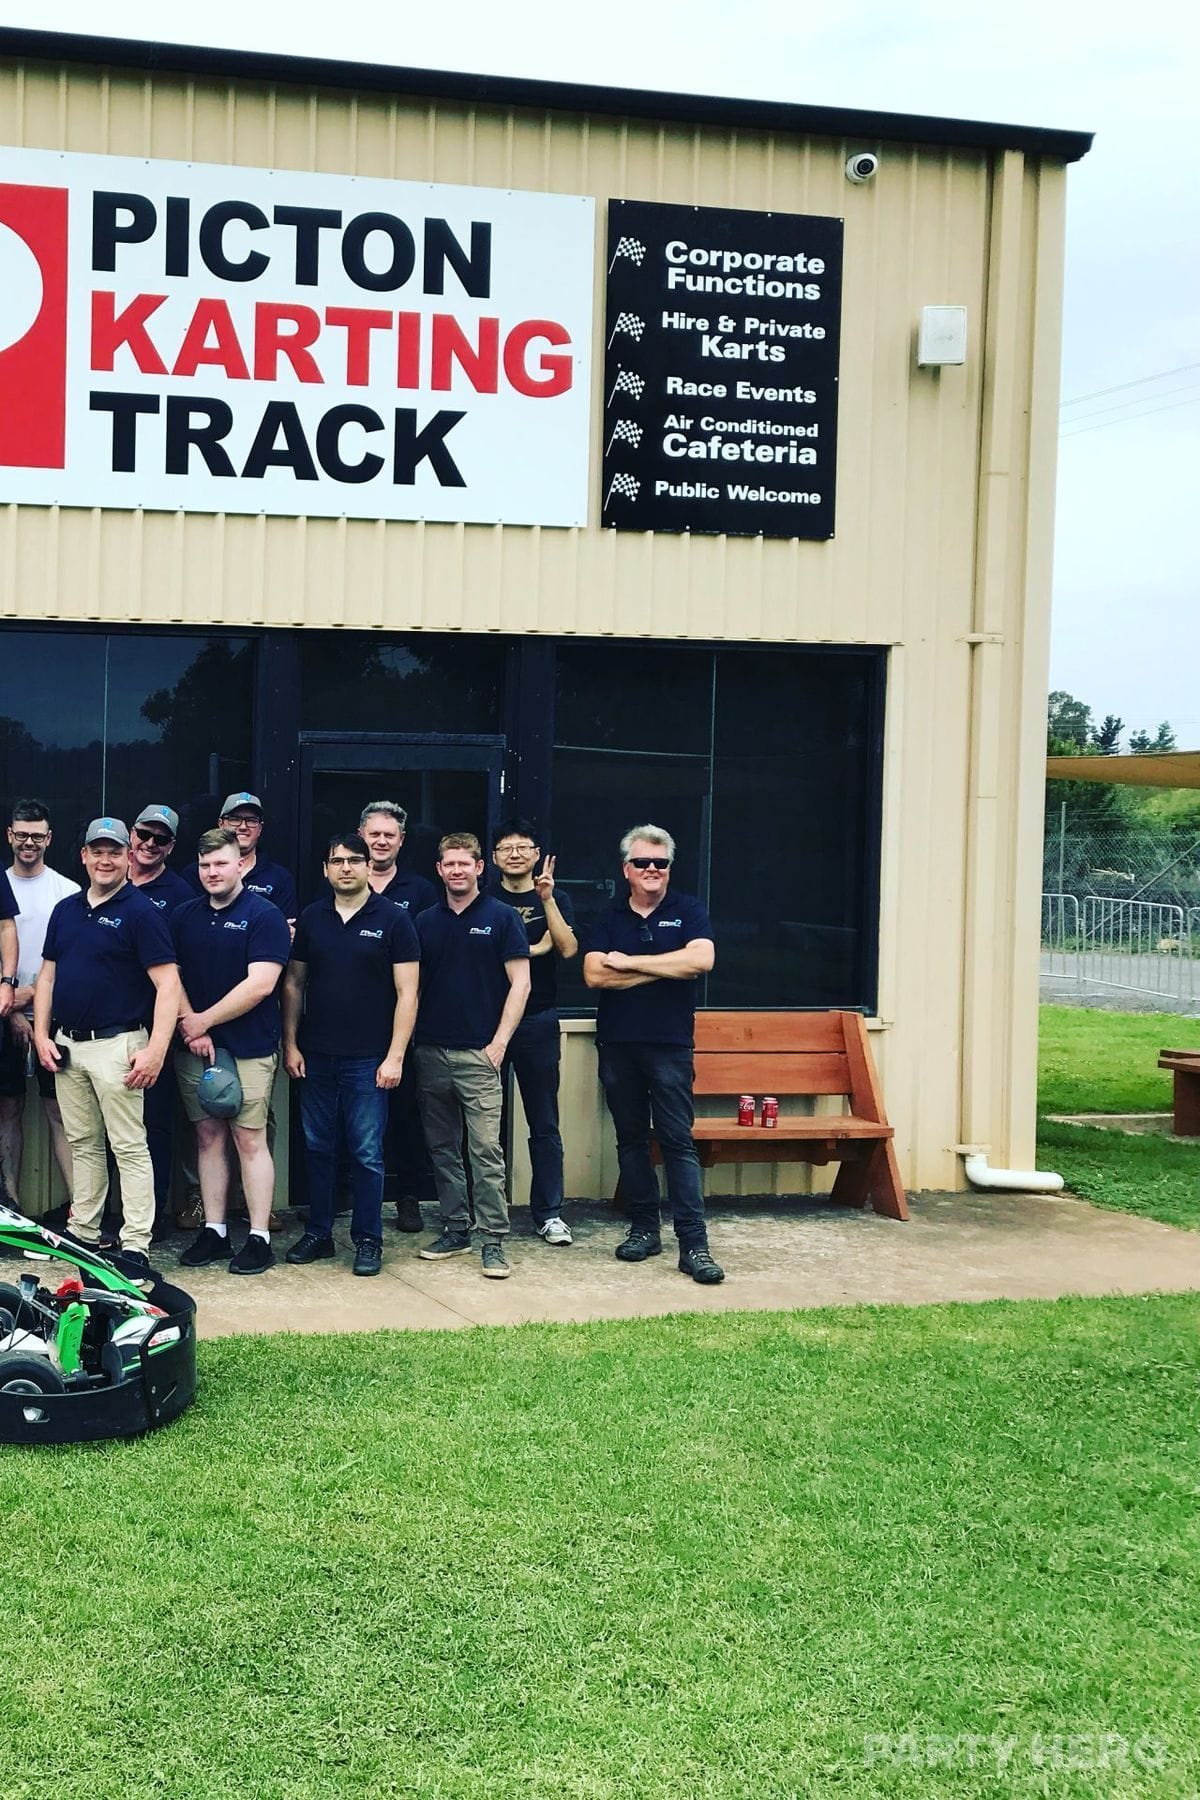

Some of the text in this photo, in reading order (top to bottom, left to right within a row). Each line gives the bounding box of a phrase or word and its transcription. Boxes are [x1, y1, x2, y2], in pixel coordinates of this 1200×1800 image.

[92, 189, 492, 299] PICTON
[665, 240, 825, 276] Corporate
[667, 267, 821, 301] Functions
[662, 312, 826, 339] Hire & Private
[89, 290, 574, 398] KARTING
[701, 334, 786, 362] Karts
[666, 376, 817, 403] Race Events
[89, 390, 467, 488] TRACK
[664, 415, 819, 437] Air Conditioned
[662, 433, 817, 465] Cafeteria
[655, 480, 821, 504] Public Welcome
